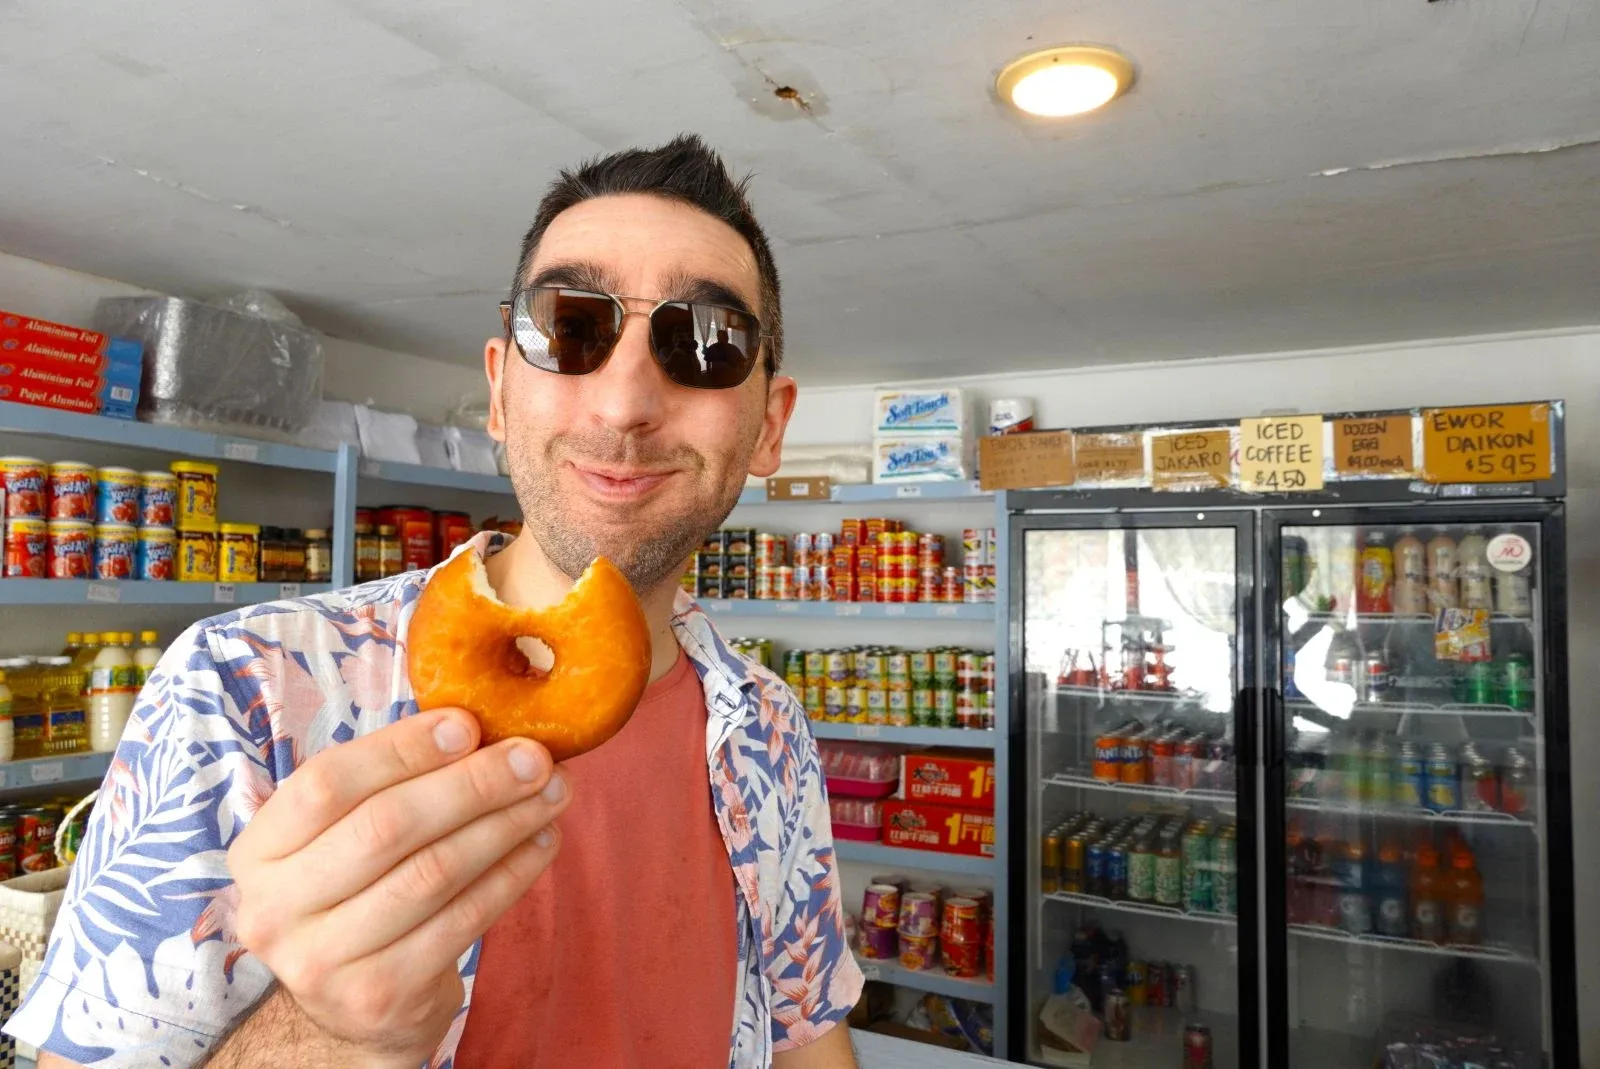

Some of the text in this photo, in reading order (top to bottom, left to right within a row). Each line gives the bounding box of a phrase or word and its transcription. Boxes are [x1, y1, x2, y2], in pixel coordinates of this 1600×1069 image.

[26, 320, 98, 344] Aluminium Foil
[24, 342, 98, 365] Aluminium Foil
[20, 367, 95, 389] Aluminium Foil
[886, 391, 949, 424] Soft Touch
[1256, 422, 1304, 441] ICED
[1343, 420, 1387, 436] DOZEN
[1433, 410, 1504, 432] EWOR
[1169, 435, 1209, 451] ICED
[1446, 429, 1535, 453] DAIKON
[1156, 451, 1222, 471] JAKARO
[1245, 443, 1313, 464] COFFEE
